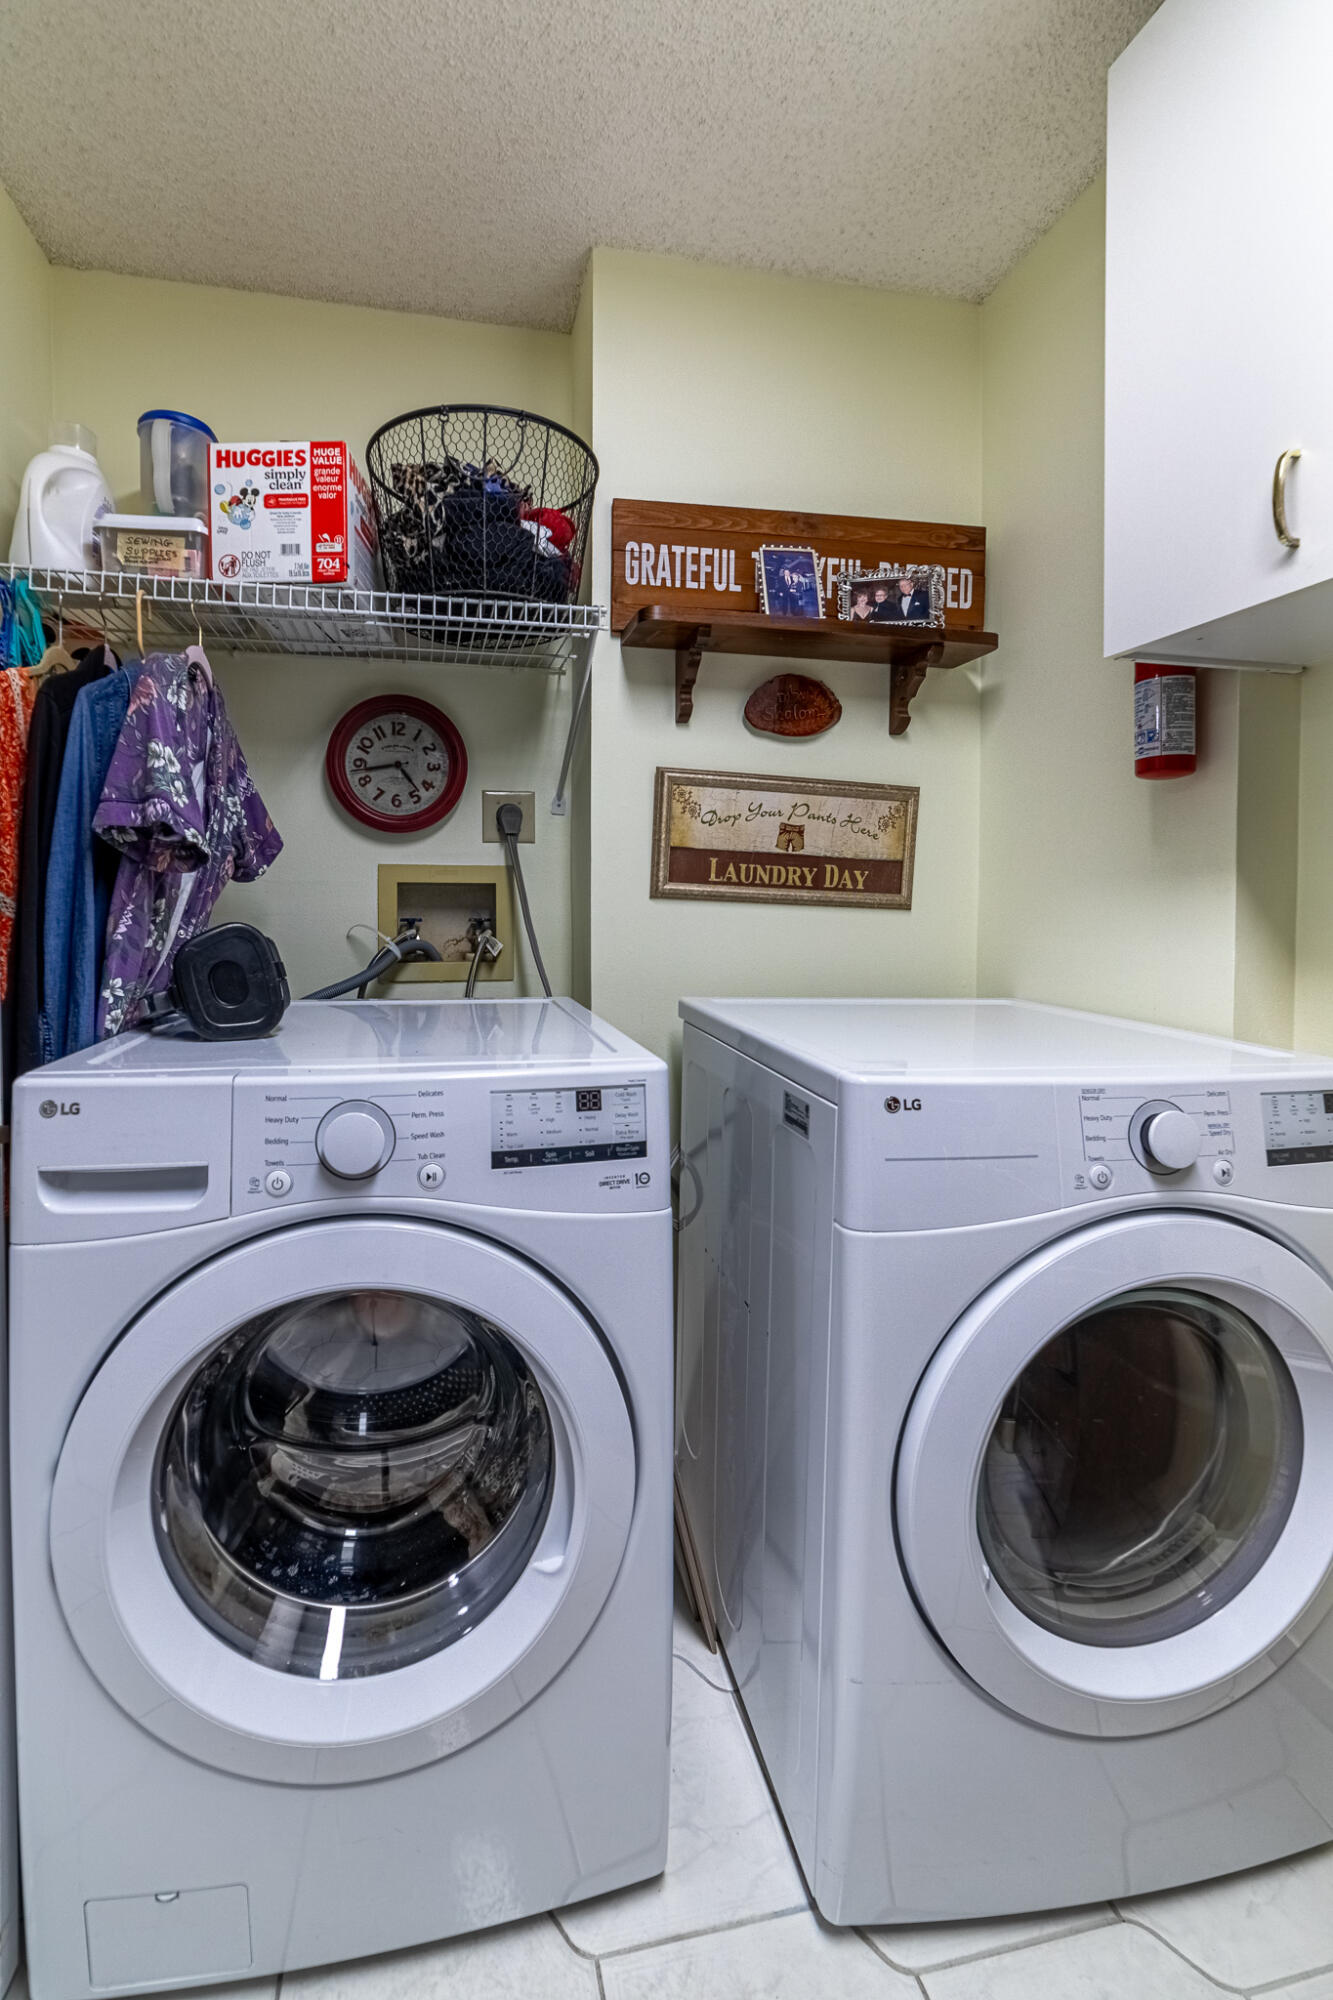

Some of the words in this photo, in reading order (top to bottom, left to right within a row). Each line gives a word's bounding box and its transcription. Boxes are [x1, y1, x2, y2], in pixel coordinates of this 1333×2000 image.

[216, 449, 307, 468] HUGGIES
[313, 448, 340, 456] HUGE
[264, 469, 306, 481] simply
[314, 467, 340, 475] grande
[269, 480, 302, 490] clean
[125, 536, 173, 547] SEWING
[241, 551, 254, 559] DO
[254, 551, 271, 559] NOT
[241, 560, 266, 568] FLUSH
[317, 558, 340, 569] 704
[625, 541, 742, 592] GRATEFUL
[372, 725, 387, 741] 11
[391, 721, 406, 736] 12
[413, 728, 422, 742] 1
[356, 737, 374, 755] 10
[422, 742, 437, 755] 2
[353, 757, 367, 770] 9
[427, 762, 441, 772] 3
[358, 774, 372, 787] 8
[421, 779, 436, 792] 4
[372, 787, 386, 801] 7
[408, 789, 421, 804] 5
[391, 794, 402, 808] 6
[701, 810, 742, 827] Drop
[744, 801, 784, 822] Your
[788, 802, 837, 825] Pants
[839, 813, 880, 840] Here
[708, 857, 818, 887] LAUNDRY
[824, 864, 869, 890] DAY
[418, 1090, 444, 1098] Delicates
[60, 1102, 80, 1115] LG
[903, 1099, 922, 1111] LG
[285, 1116, 299, 1124] Duty
[264, 1138, 289, 1146] Bedding
[410, 1132, 428, 1141] Speed
[635, 1172, 651, 1185] 10
